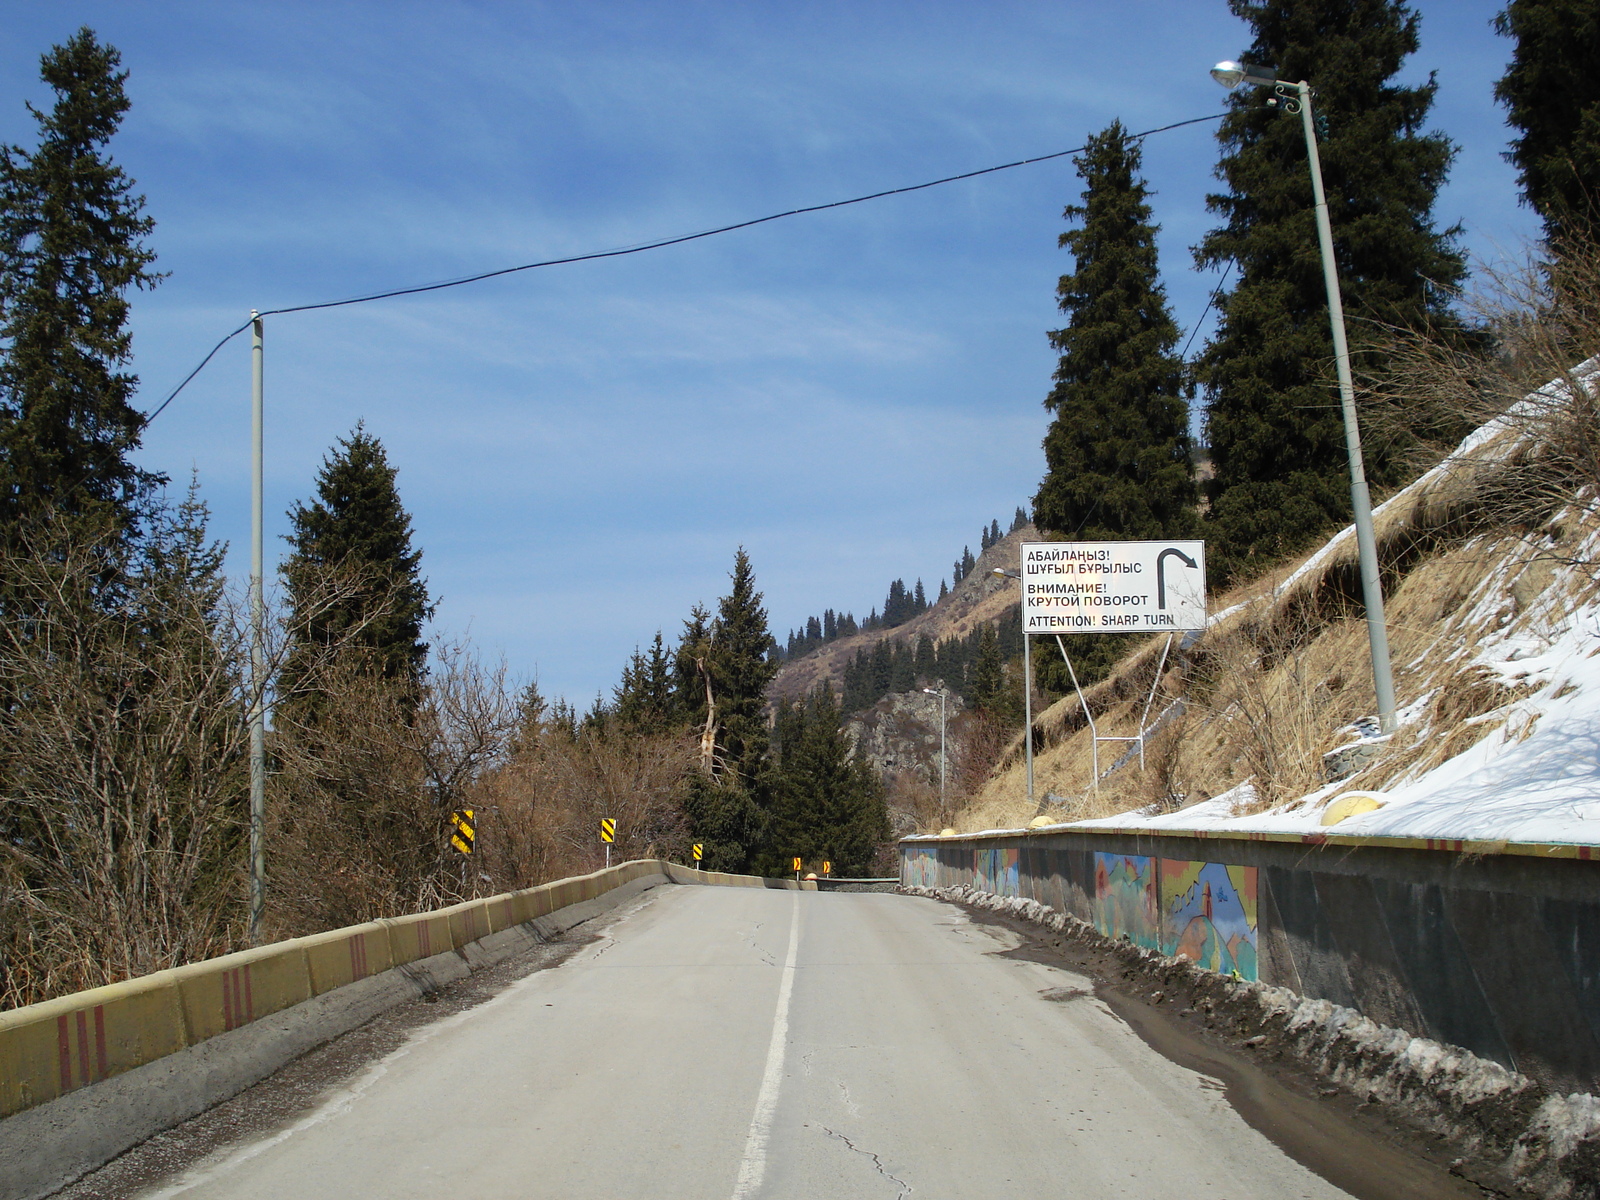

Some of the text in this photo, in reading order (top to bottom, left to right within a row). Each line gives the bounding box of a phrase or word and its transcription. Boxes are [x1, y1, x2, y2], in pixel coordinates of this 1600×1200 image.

[1027, 583, 1107, 594] ВНИМАНИЕ!
[1027, 594, 1148, 607] КРУТОЙ ПОВОРОТ
[1028, 614, 1175, 627] ATTENTION! SHARP TURN
